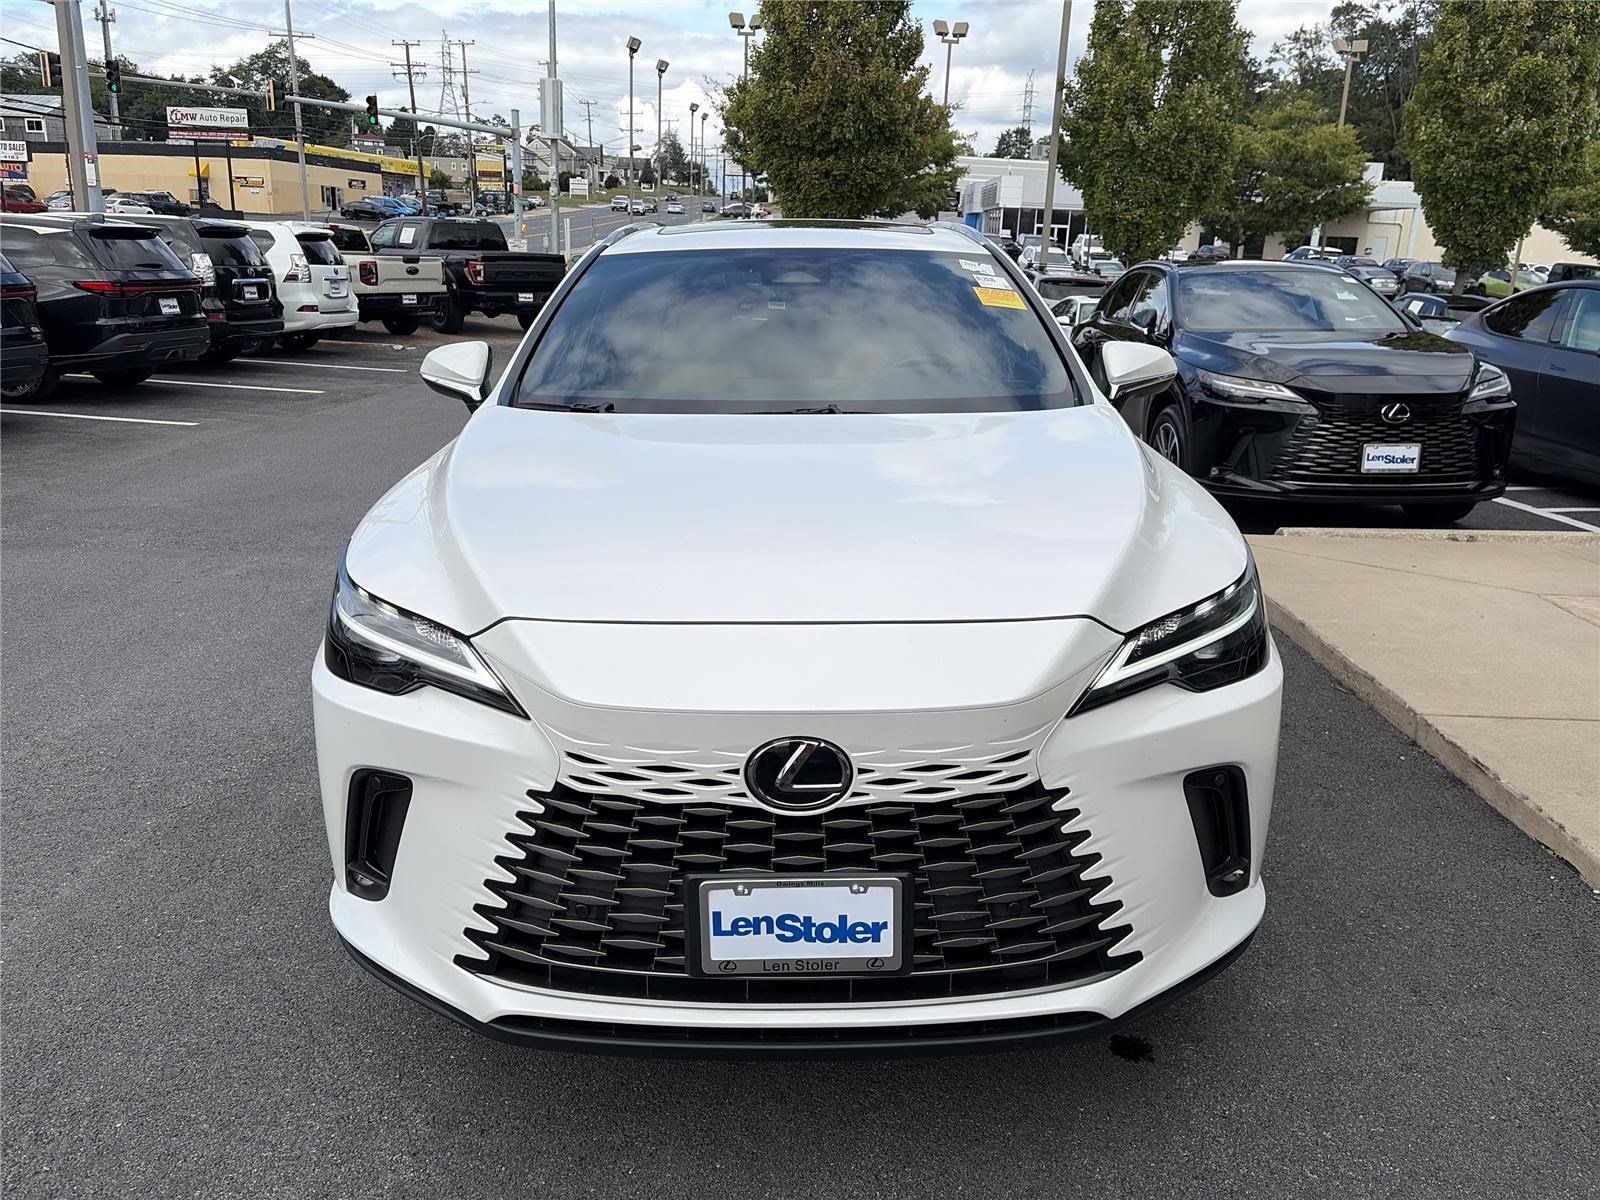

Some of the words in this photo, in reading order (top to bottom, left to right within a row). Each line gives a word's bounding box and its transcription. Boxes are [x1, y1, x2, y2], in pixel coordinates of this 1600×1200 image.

[175, 113, 197, 121] LMW
[199, 113, 218, 121] Auto
[219, 114, 246, 124] Repair
[8, 143, 25, 151] SALES
[763, 960, 790, 972] Len
[794, 959, 840, 971] Stoler
